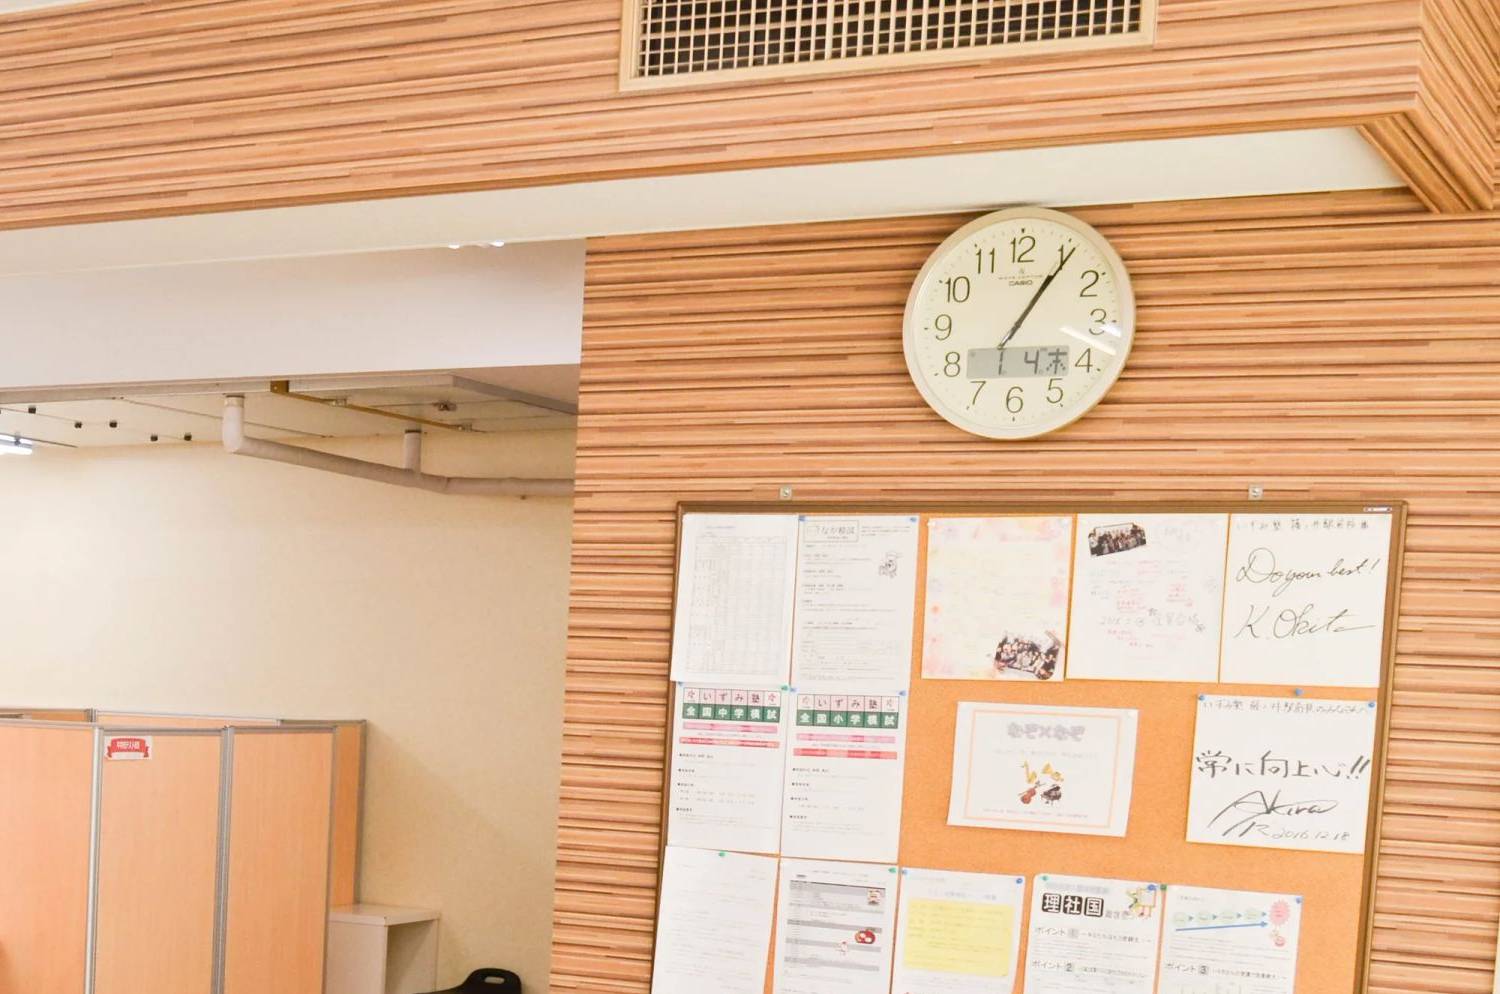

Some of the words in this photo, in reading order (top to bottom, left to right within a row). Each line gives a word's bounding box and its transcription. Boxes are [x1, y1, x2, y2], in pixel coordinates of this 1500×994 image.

[975, 247, 996, 274] 11
[1010, 236, 1036, 263] 12
[946, 276, 970, 303] 10
[1079, 270, 1100, 298] 2
[934, 313, 953, 341] 9
[1088, 308, 1107, 335] 3
[943, 351, 961, 378] 8
[1074, 347, 1093, 374] 4
[970, 380, 987, 406] 7
[1005, 386, 1024, 414] 6
[1046, 378, 1064, 404] 5
[1236, 547, 1282, 584] Do
[1326, 557, 1382, 578] best!
[702, 691, 762, 704] いずみ塾
[816, 696, 879, 710] いずみ塾
[684, 705, 780, 721] 全国中学模試
[799, 712, 897, 728] 全国小学模試
[1043, 893, 1104, 917] 理社国
